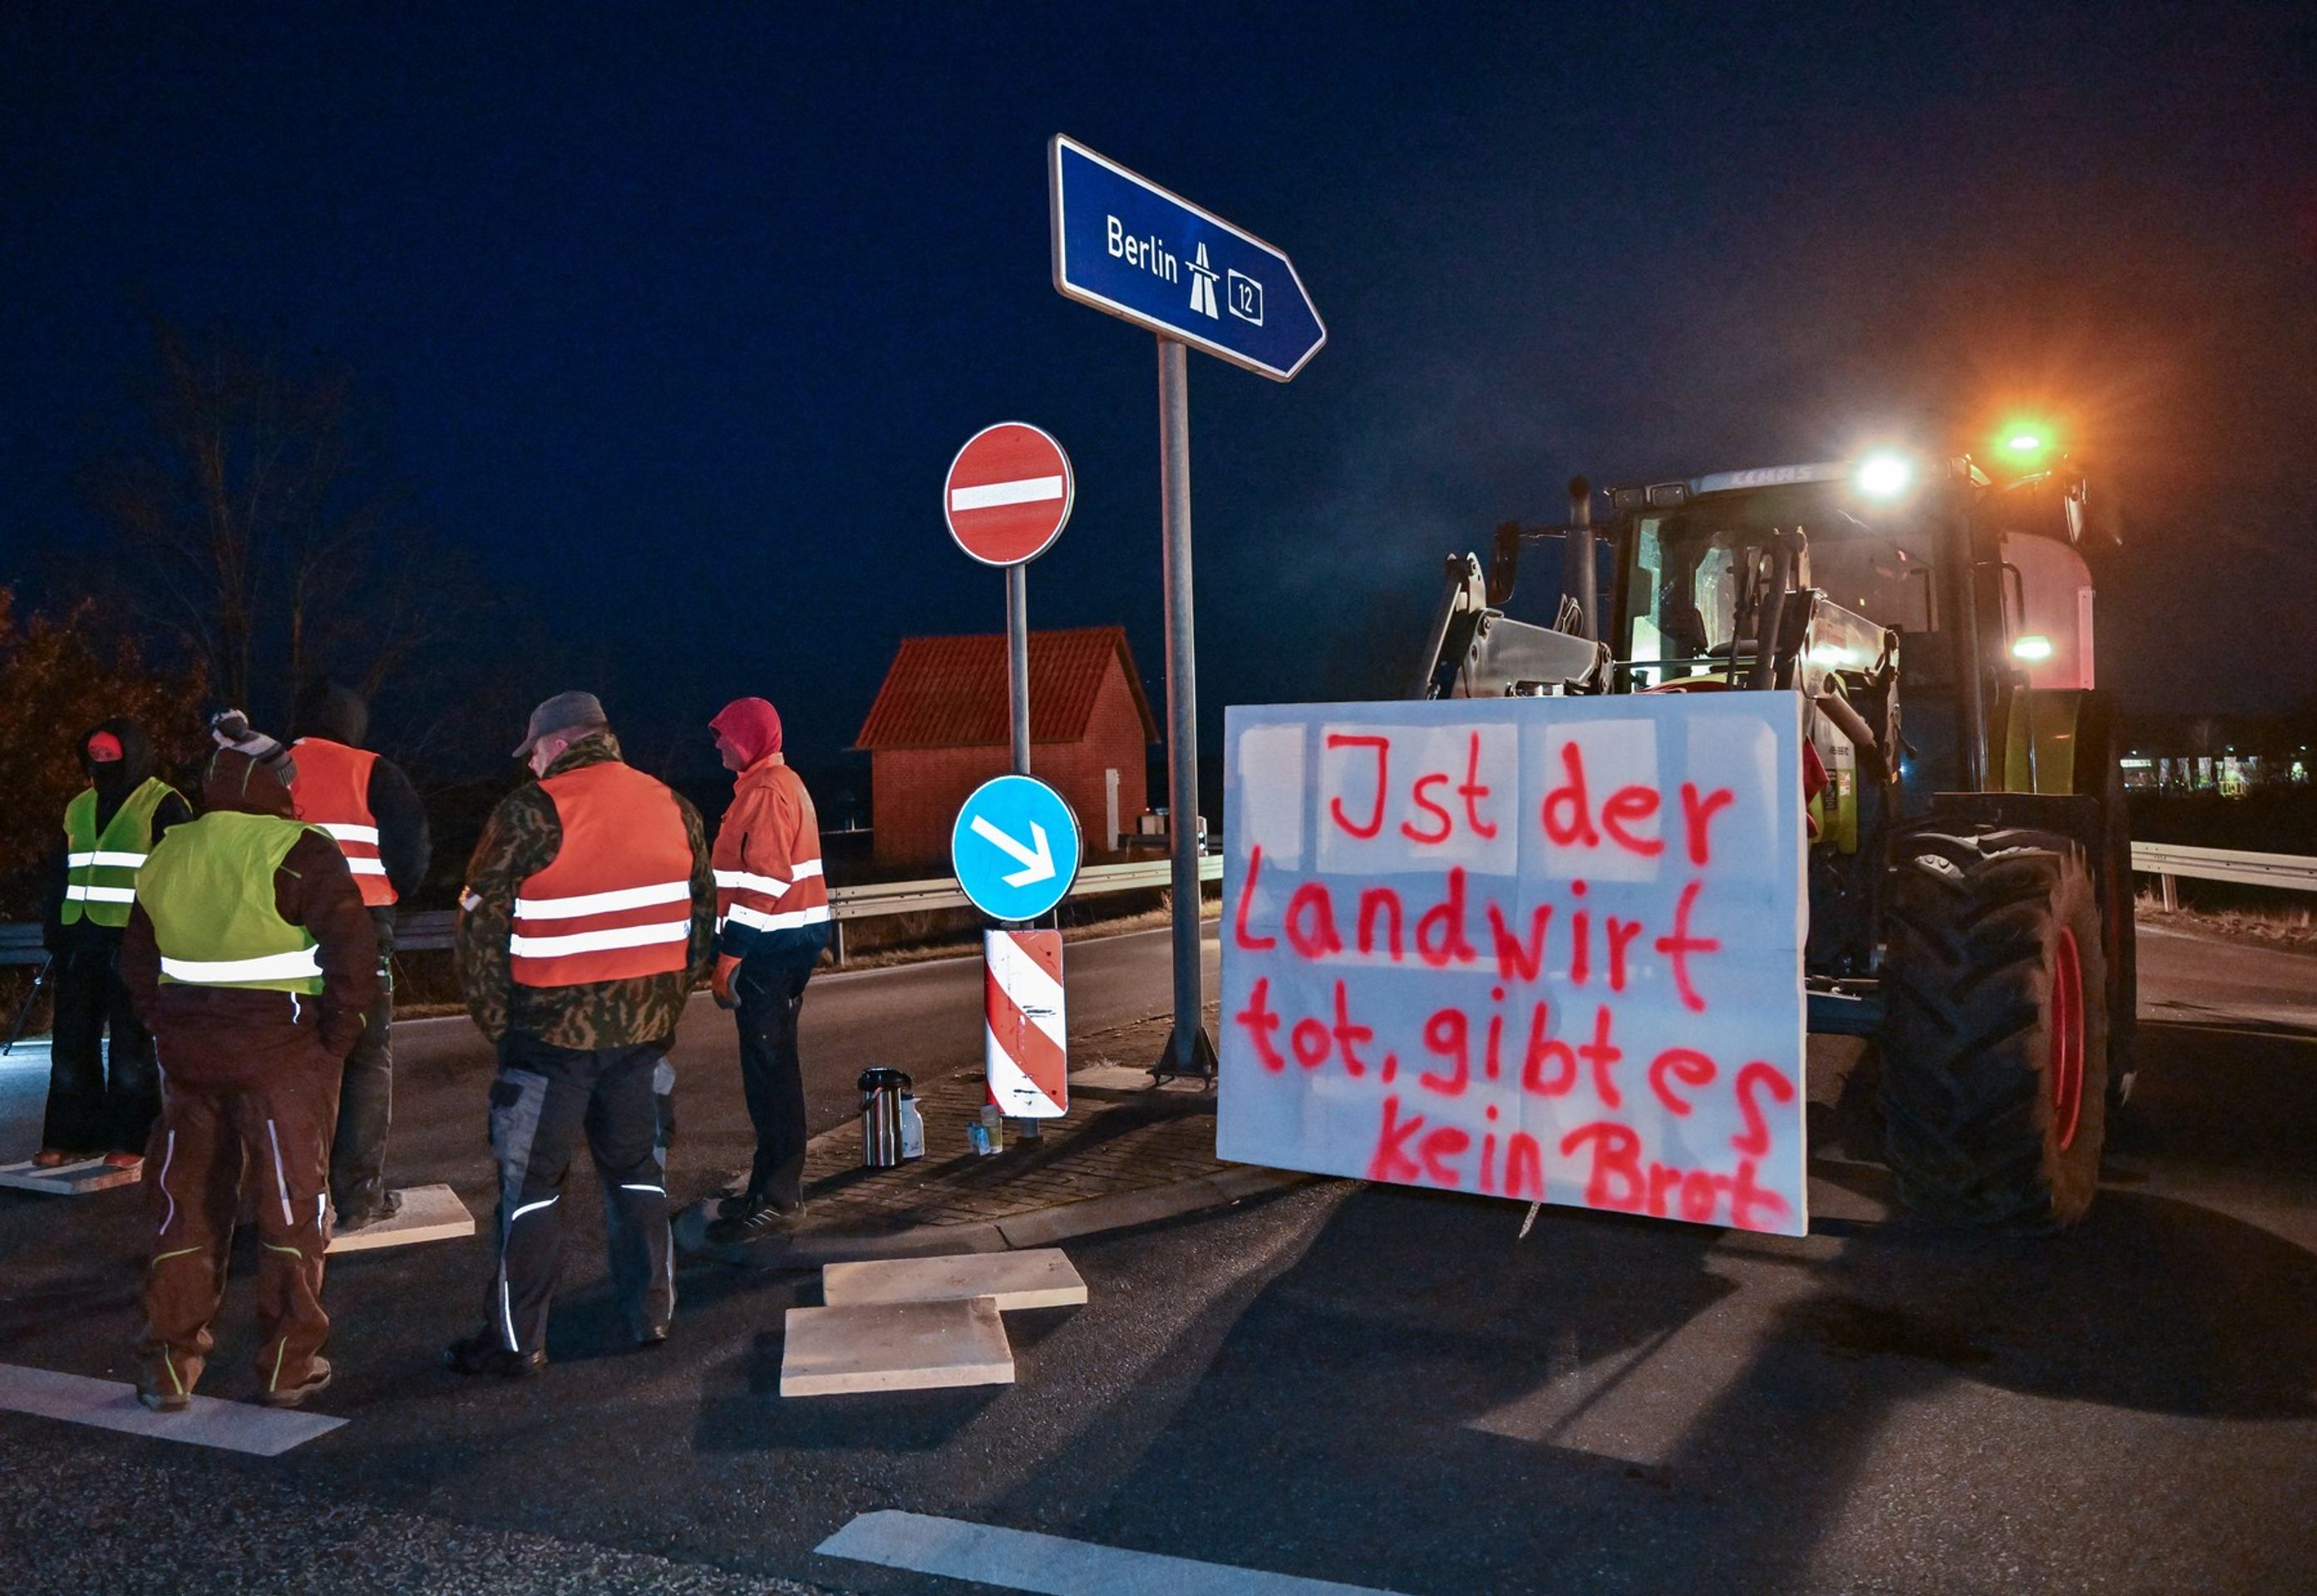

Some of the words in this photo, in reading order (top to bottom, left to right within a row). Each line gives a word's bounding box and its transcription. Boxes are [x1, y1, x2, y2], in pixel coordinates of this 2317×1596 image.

[1107, 214, 1177, 283] Berlin
[1239, 283, 1253, 313] 12
[1540, 740, 1736, 868] der
[1235, 844, 1722, 1013] Landwirt
[1235, 977, 1398, 1085] tot,
[1559, 1121, 1794, 1232] Brot
